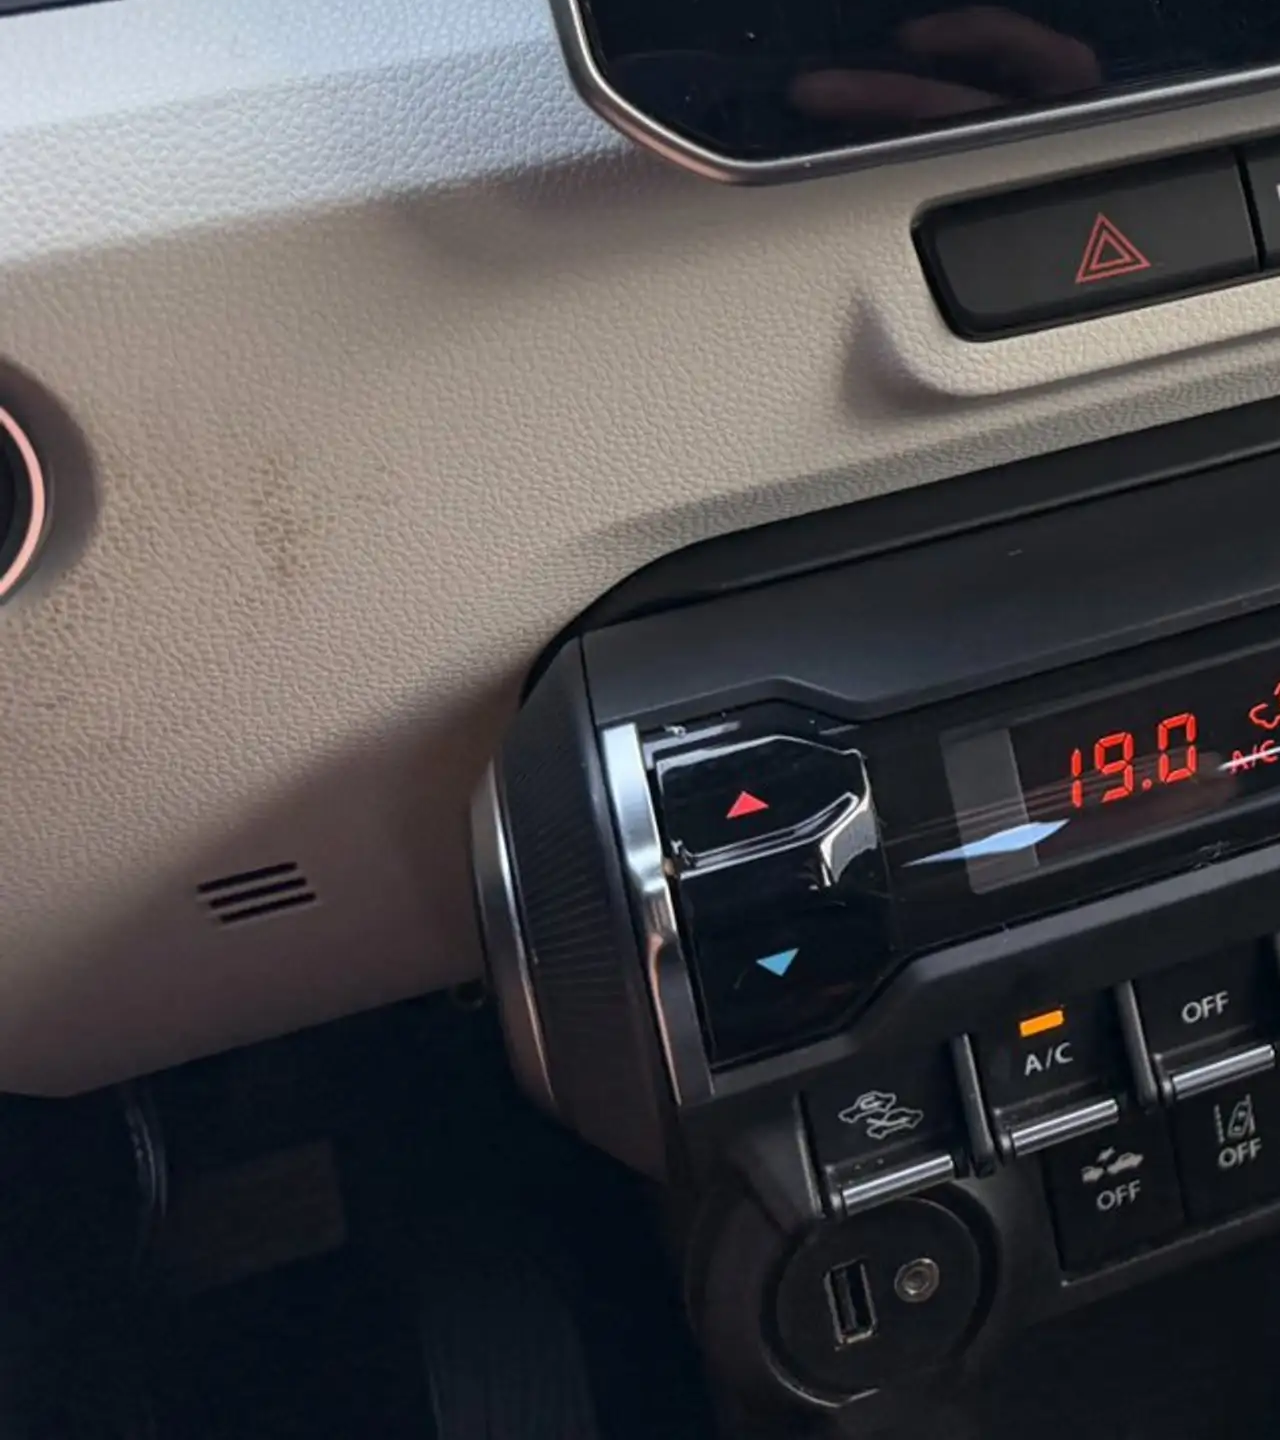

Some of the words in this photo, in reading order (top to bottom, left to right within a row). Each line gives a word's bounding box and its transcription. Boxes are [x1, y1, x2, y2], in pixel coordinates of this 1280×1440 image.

[1071, 712, 1196, 808] 19.0
[1229, 739, 1278, 774] A/C
[1181, 991, 1230, 1023] OFF
[1023, 1042, 1074, 1077] A/C
[1218, 1138, 1262, 1170] OFF
[1096, 1180, 1141, 1212] OFF
